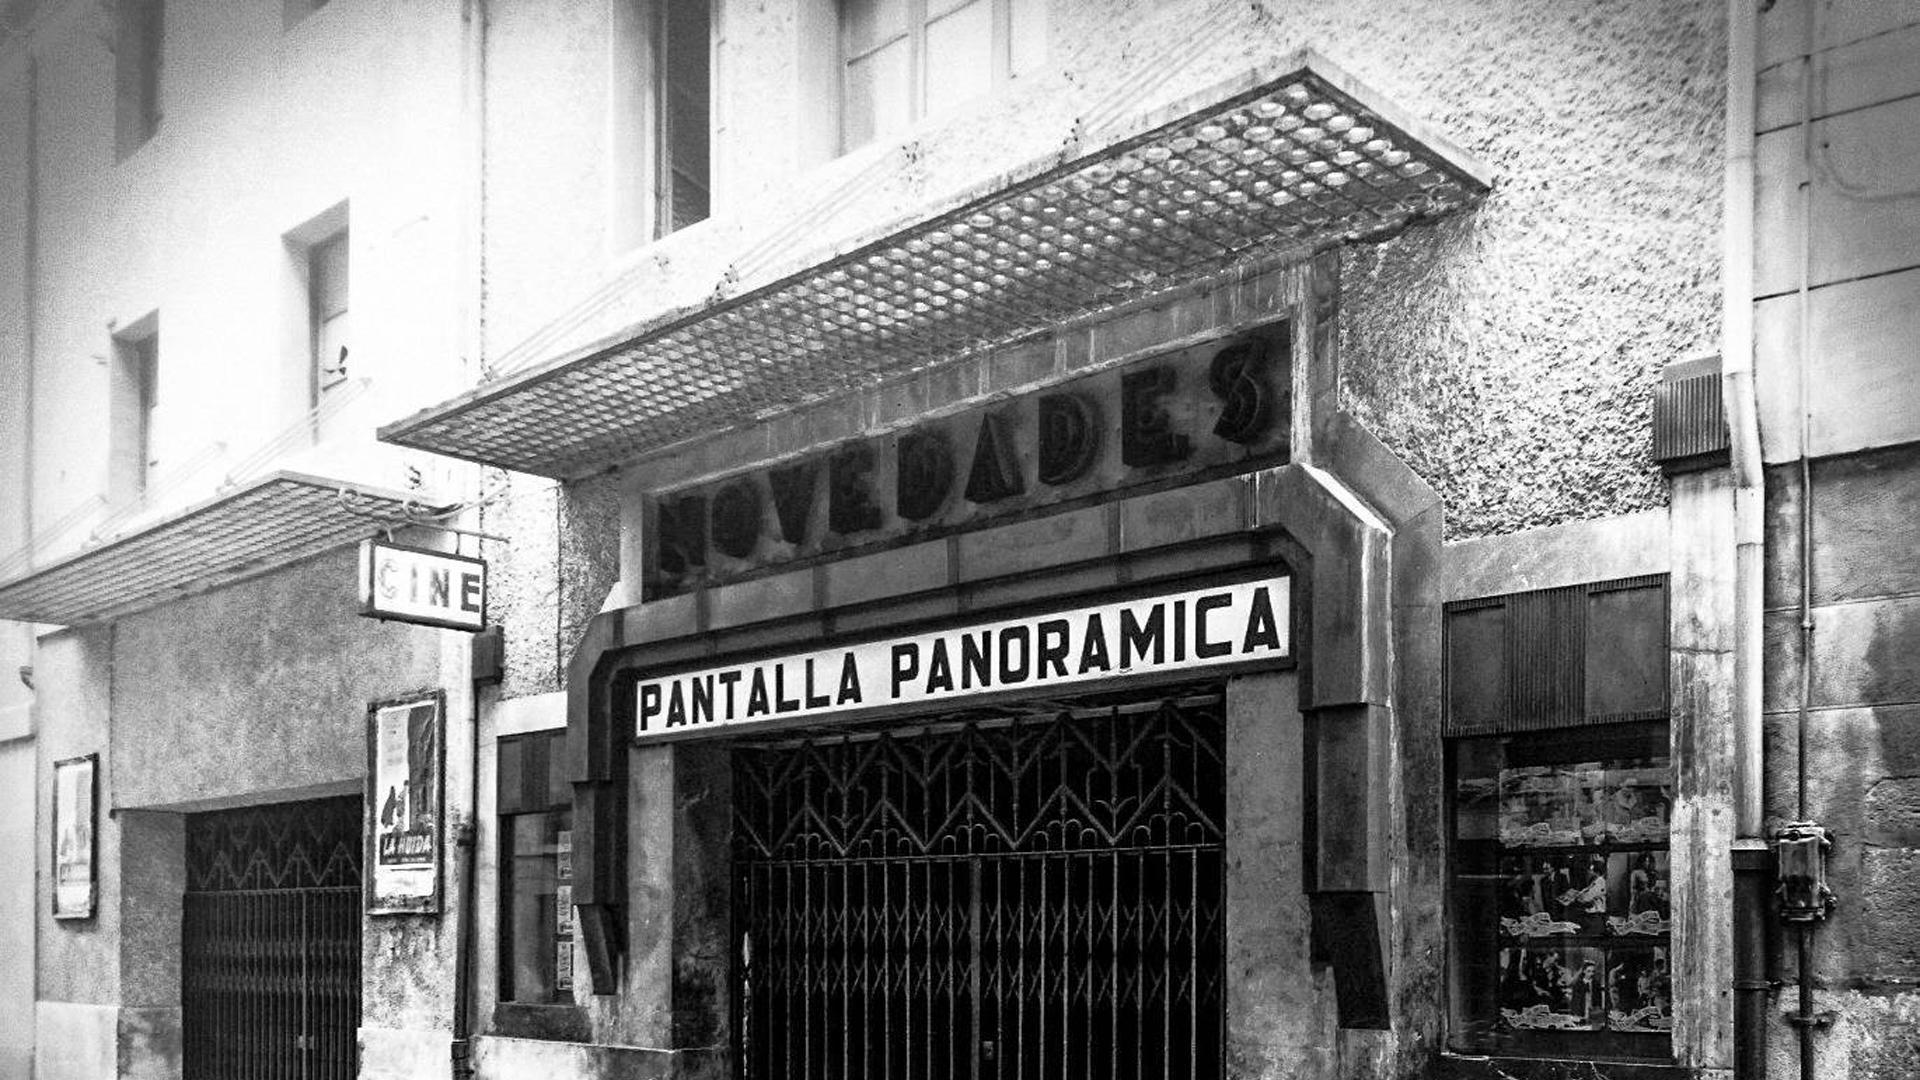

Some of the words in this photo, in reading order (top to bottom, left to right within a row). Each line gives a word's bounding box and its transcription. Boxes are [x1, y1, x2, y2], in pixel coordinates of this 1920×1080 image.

[659, 338, 1275, 574] NOVEDADES
[378, 558, 481, 614] CINE
[639, 652, 863, 732] PANTALLA
[891, 586, 1281, 700] PANORAMICA
